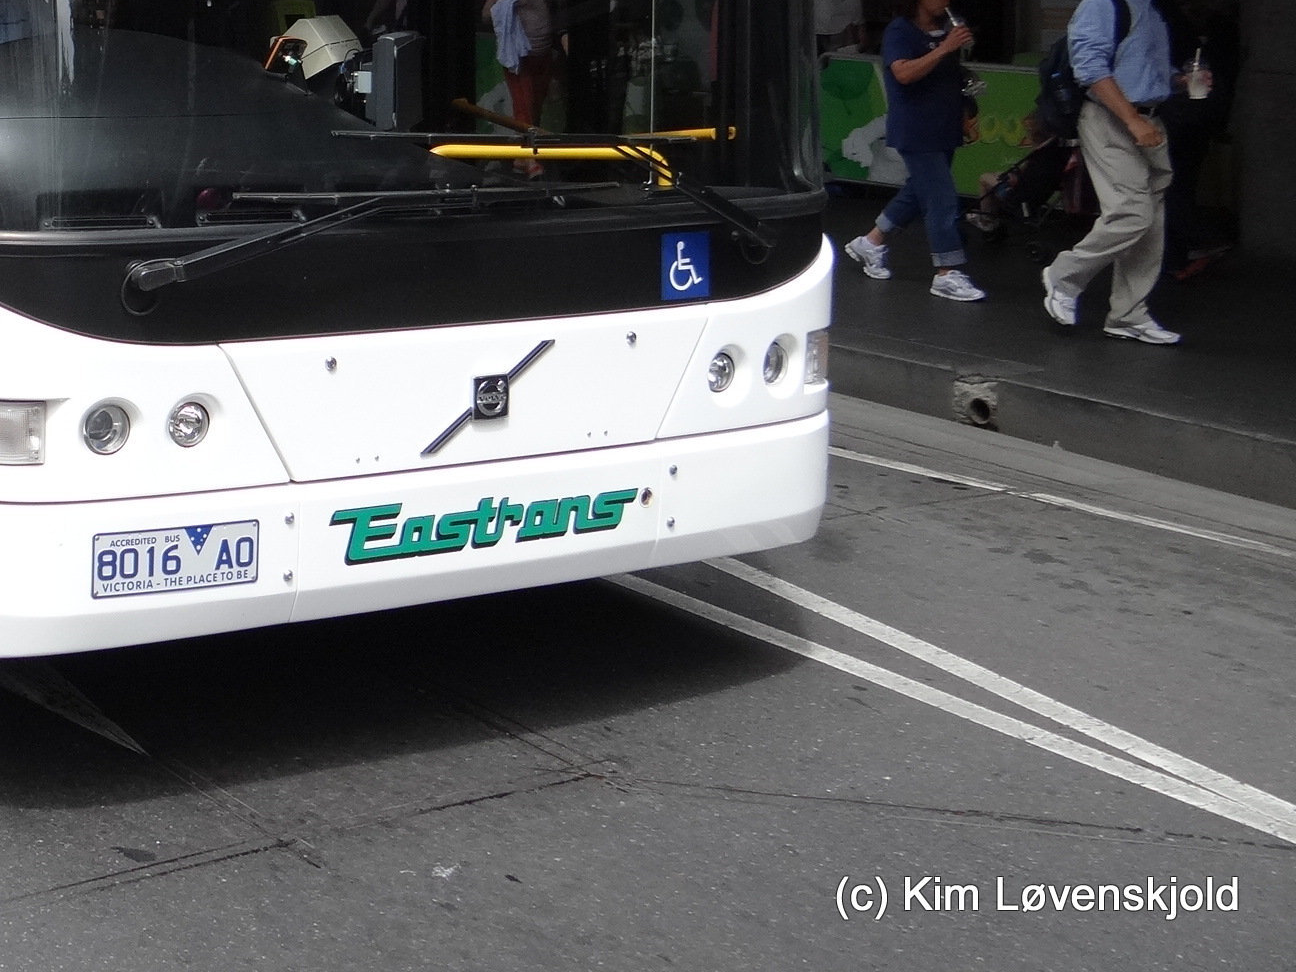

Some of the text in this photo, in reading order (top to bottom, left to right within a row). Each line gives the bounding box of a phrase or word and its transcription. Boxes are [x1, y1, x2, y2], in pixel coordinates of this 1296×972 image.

[109, 534, 181, 548] ACCREDITED BUS
[329, 488, 638, 566] Eastrans
[97, 544, 181, 581] 8016
[102, 579, 154, 593] VICTORIA
[164, 577, 183, 588] THE
[186, 573, 218, 585] PLACE
[220, 571, 234, 581] TO
[237, 569, 249, 579] BE
